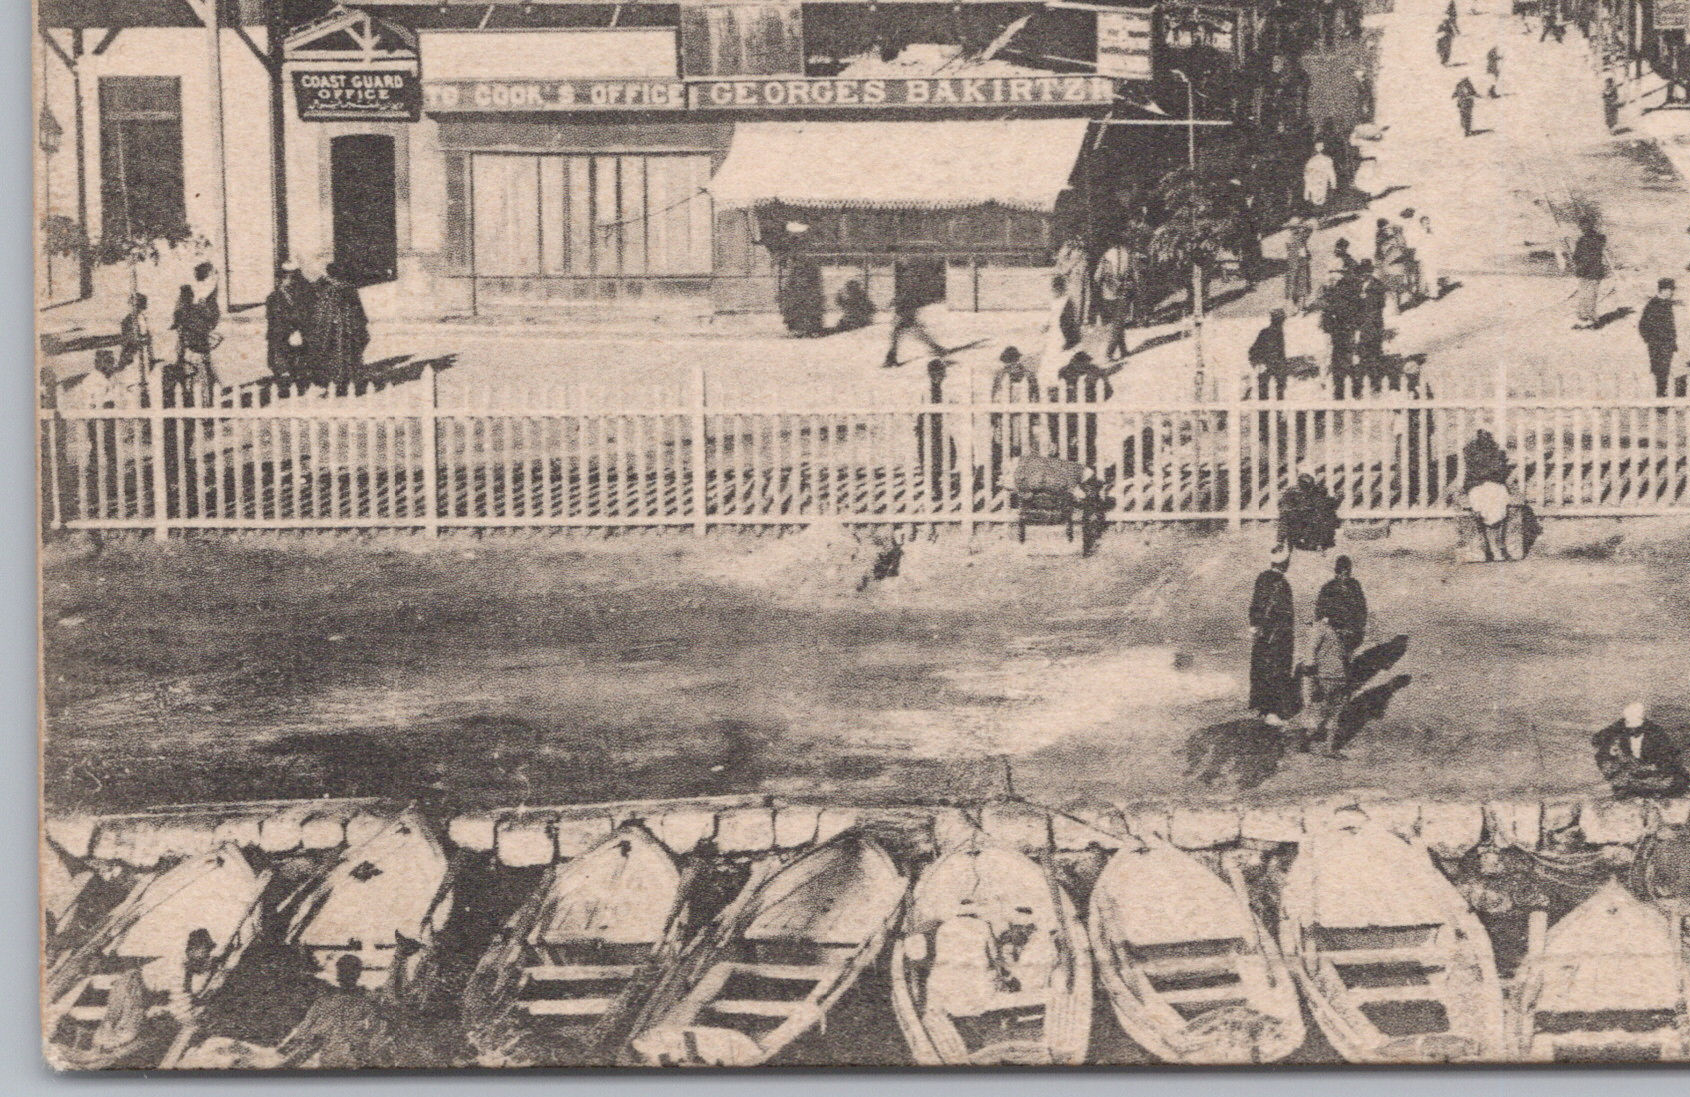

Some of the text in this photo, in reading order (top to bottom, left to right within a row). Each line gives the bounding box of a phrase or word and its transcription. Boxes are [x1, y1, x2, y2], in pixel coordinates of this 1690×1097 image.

[301, 74, 404, 88] COAST GUARD
[318, 88, 390, 100] OFFICE
[590, 83, 685, 106] OFFICE
[710, 80, 888, 105] GEORGES
